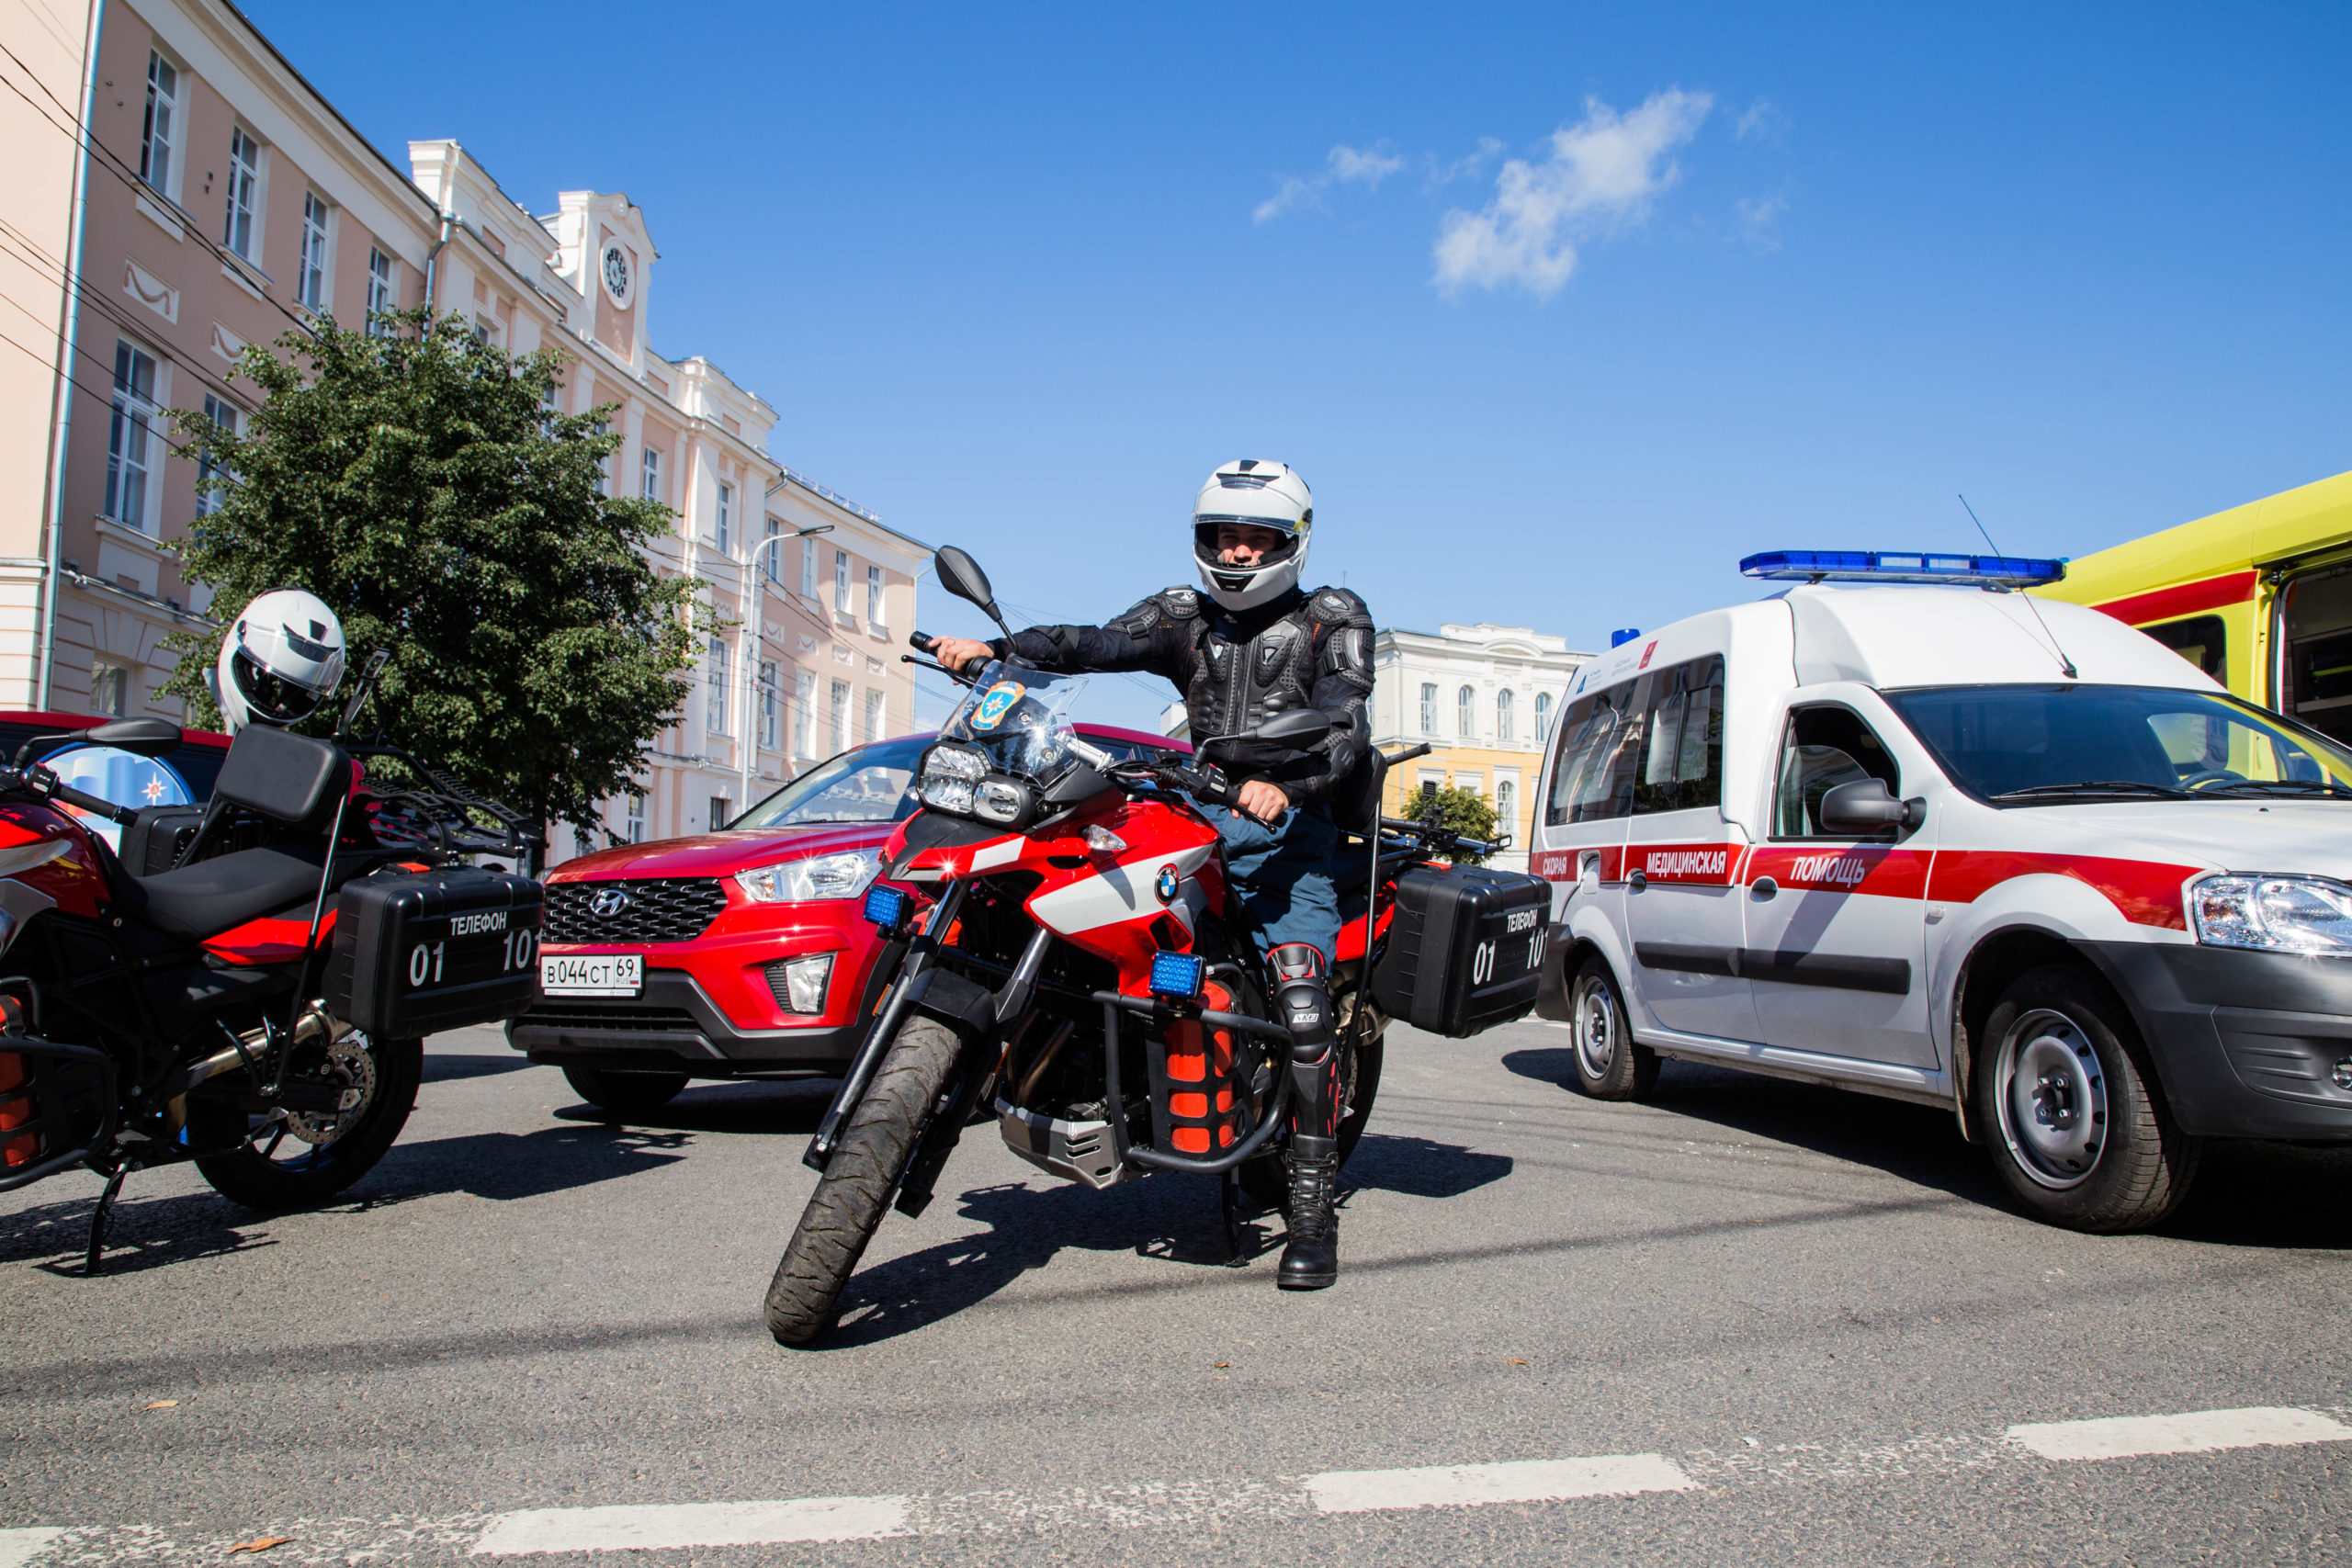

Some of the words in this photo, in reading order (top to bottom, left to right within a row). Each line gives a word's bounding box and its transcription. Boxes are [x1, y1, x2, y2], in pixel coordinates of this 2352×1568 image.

[1543, 856, 1567, 875] СКОРАЯ
[1646, 851, 1727, 878] МЕДИЦИНСКАЯ
[1790, 856, 1865, 888] ПОМОЩЬ
[450, 911, 507, 936] ТЕЛЕФОН
[1507, 908, 1538, 933] ТЕЛЕФОН
[410, 941, 445, 987] 01
[616, 958, 634, 977] 69
[1473, 940, 1496, 986] 01
